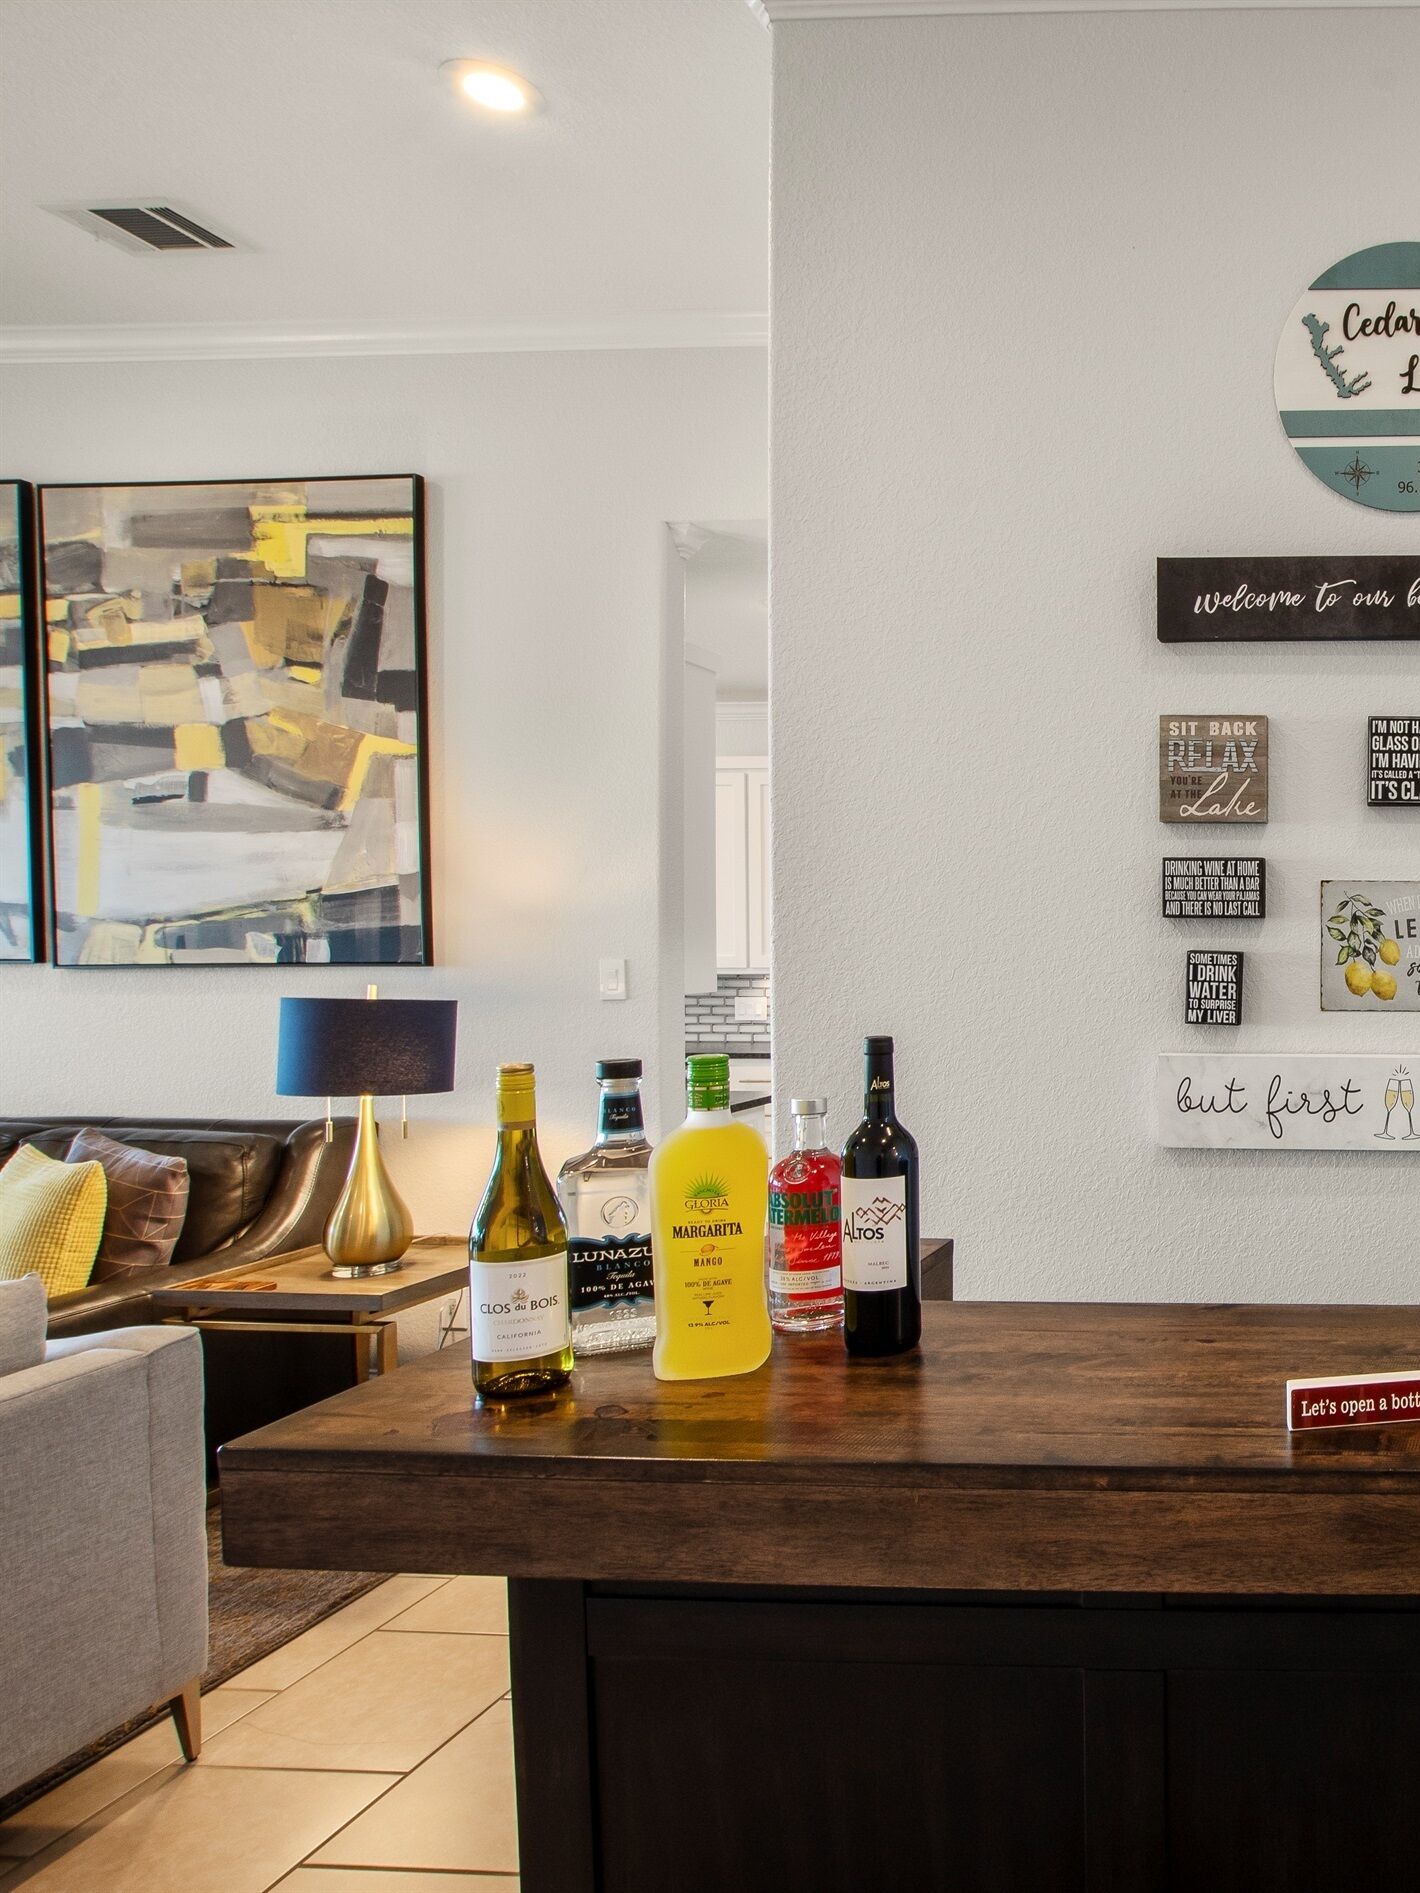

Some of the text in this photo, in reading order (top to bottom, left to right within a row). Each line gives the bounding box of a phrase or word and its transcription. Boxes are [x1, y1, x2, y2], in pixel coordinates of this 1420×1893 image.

[1193, 584, 1306, 614] welcome
[1314, 579, 1357, 612] to
[1352, 590, 1395, 607] our
[1169, 721, 1257, 736] SIT BACK
[1372, 720, 1387, 734] I'M
[1390, 720, 1410, 734] NOT
[1372, 736, 1409, 751] GLASS
[1168, 738, 1258, 773] RELAX
[1372, 753, 1389, 768] I'M
[1170, 775, 1202, 785] YOU'RE
[1371, 770, 1383, 778] IT'S
[1384, 770, 1407, 779] CALLED
[1408, 770, 1413, 779] A
[1170, 790, 1201, 799] AT THE
[1180, 772, 1261, 816] Lake
[1371, 780, 1398, 799] IT'S
[1165, 860, 1260, 876] DRINKING WINE AT HOME
[1165, 877, 1259, 890] IS MUCH BETTER THAN A BAR
[1165, 891, 1260, 900] BECAUSE YOU CAN WEAR YOUR PAJAMAS
[1165, 901, 1260, 915] AND THERE IS NO LAST CALL
[1386, 895, 1415, 914] WHEN
[1190, 953, 1238, 965] SOMETIMES
[1189, 964, 1237, 982] I DRINK
[1189, 981, 1236, 999] WATER
[1188, 999, 1236, 1010] TO SURPRISE
[1188, 1009, 1236, 1023] MY LIVER
[1177, 1077, 1248, 1113] but
[1266, 1075, 1364, 1139] first
[685, 1198, 729, 1209] GLORIA
[672, 1222, 743, 1239] MARGARITA
[573, 1246, 653, 1263] LUNAZU
[596, 1260, 651, 1271] BLANCO
[693, 1257, 723, 1267] MANGO
[606, 1270, 636, 1281] Tequila
[581, 1280, 654, 1293] 100% DE AGAV
[480, 1303, 511, 1314] CLOS
[515, 1302, 526, 1311] du
[497, 1330, 541, 1340] CALIFORNIA
[1301, 1400, 1337, 1417] Let's
[1340, 1398, 1375, 1416] open
[1379, 1398, 1388, 1411] a
